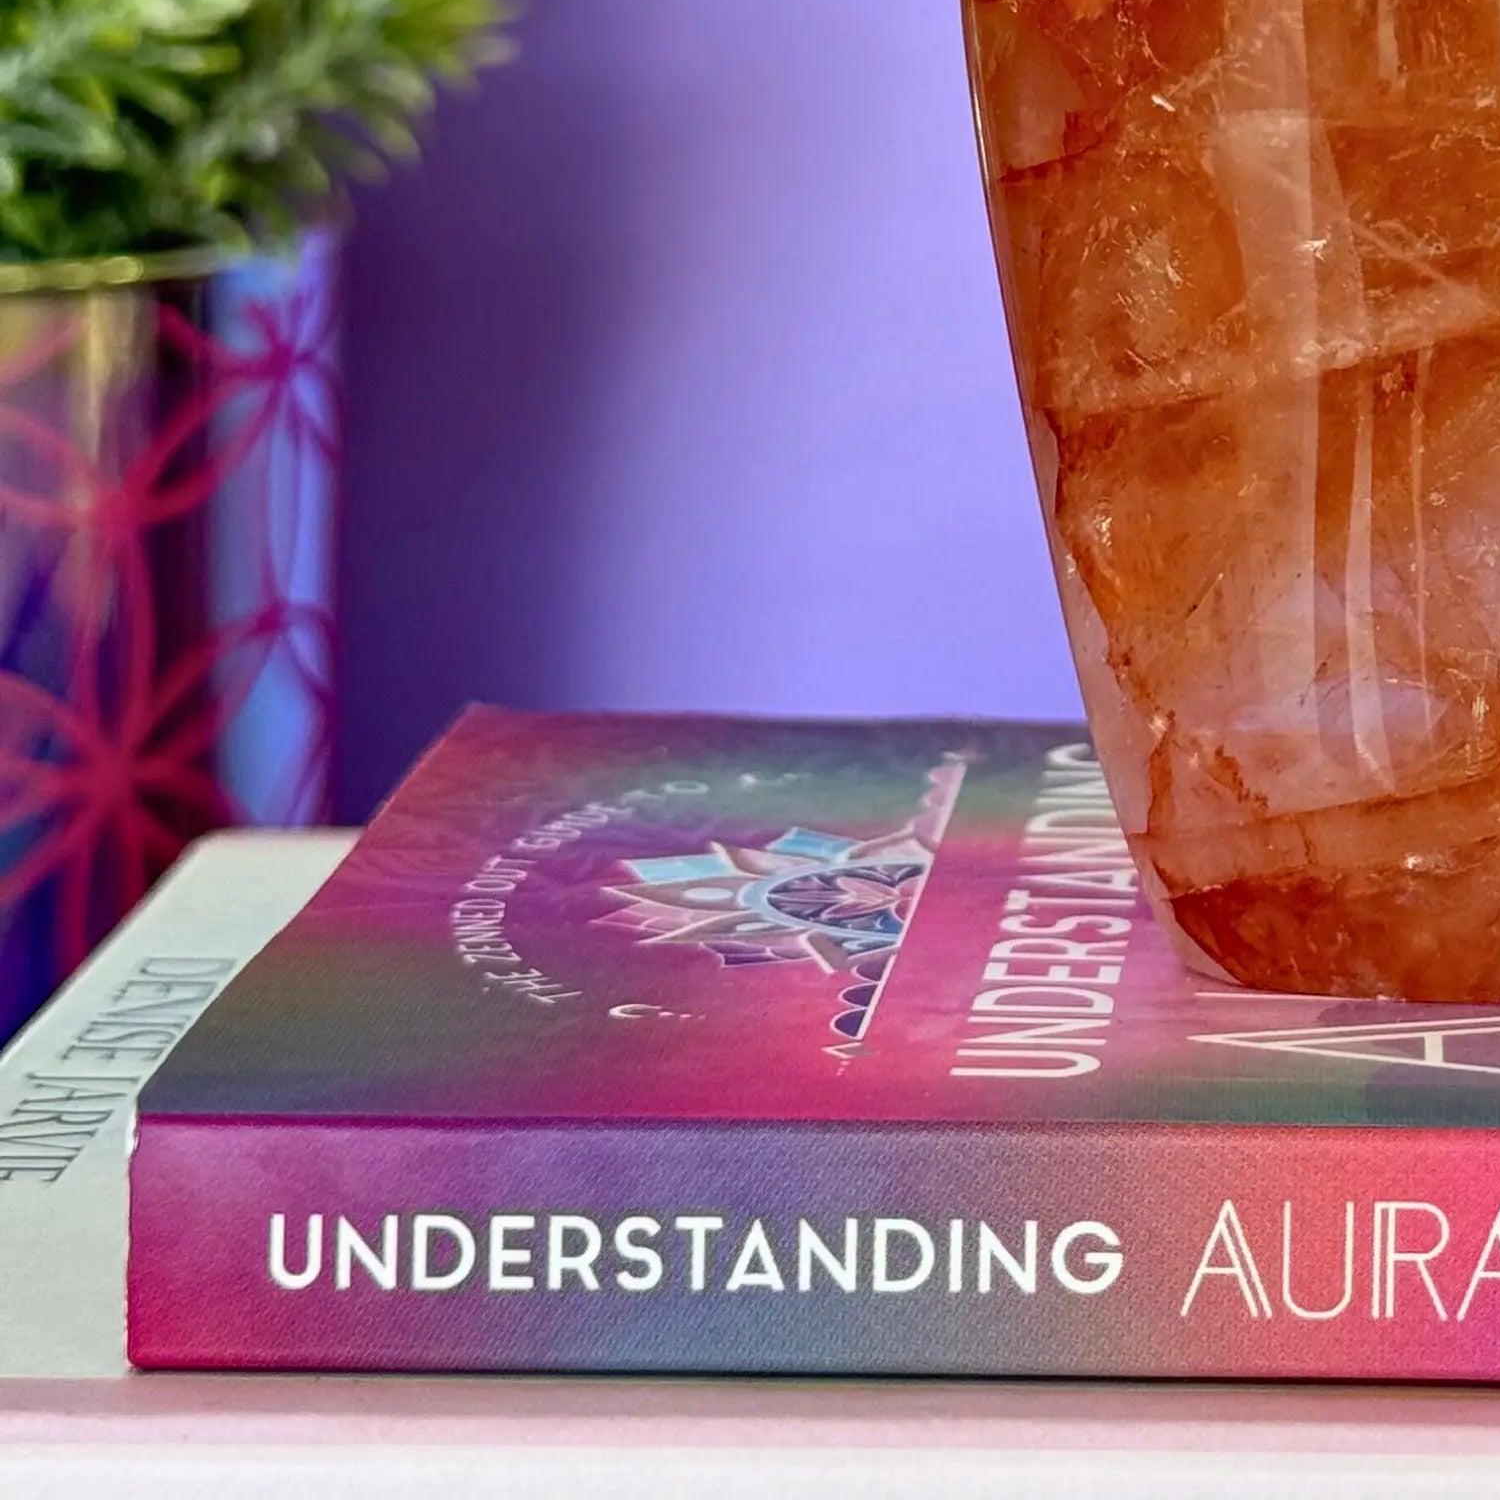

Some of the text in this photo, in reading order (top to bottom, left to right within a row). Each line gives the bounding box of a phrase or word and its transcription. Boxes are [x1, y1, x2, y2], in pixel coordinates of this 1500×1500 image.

[465, 854, 537, 894] OUT
[453, 898, 522, 966] ZENNED
[60, 956, 238, 1061] DENISE
[484, 965, 583, 1005] THE
[267, 1212, 1125, 1296] UNDERSTANDING
